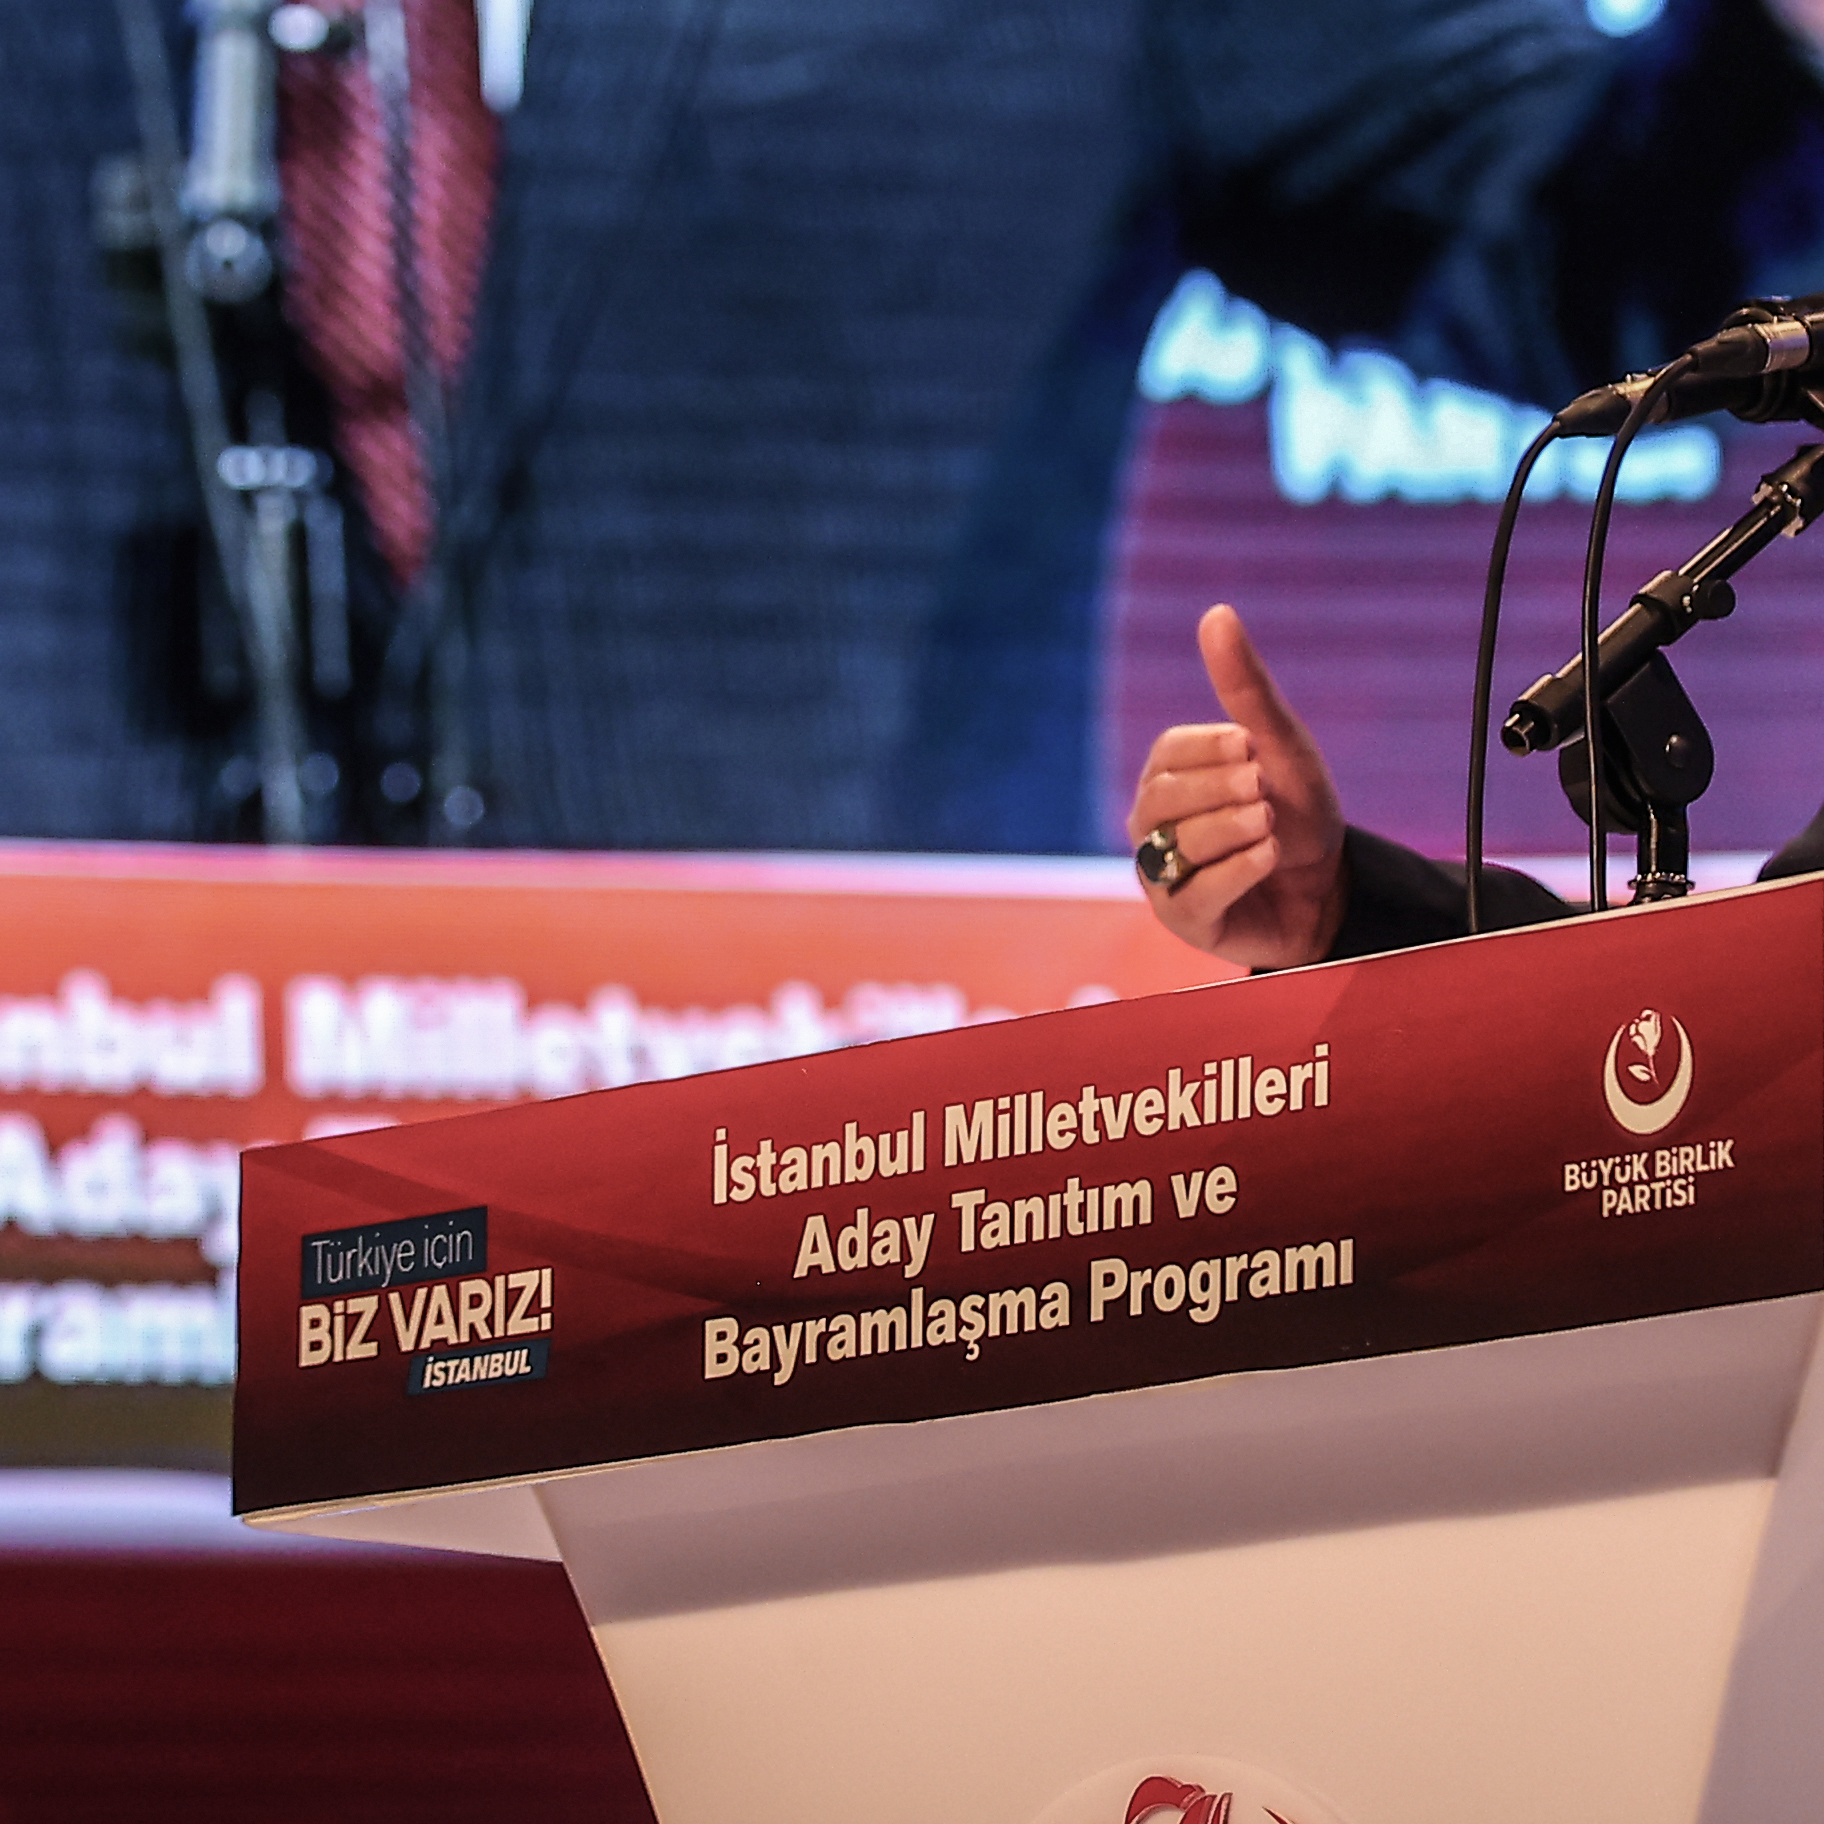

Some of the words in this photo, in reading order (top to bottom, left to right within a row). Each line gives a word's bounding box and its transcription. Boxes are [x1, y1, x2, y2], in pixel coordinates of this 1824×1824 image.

[712, 1110, 926, 1204] İstanbul
[943, 1043, 1330, 1168] Milletvekilleri
[1564, 1152, 1649, 1192] BÜYÜK
[1655, 1139, 1735, 1180] BİRLİK
[793, 1207, 935, 1278] Aday
[951, 1176, 1152, 1252] Tanıtım
[1170, 1165, 1237, 1219] ve
[1601, 1176, 1696, 1218] PARTİSİ
[311, 1232, 415, 1288] Türkiye
[424, 1220, 473, 1270] için
[298, 1294, 379, 1368] BİZ
[387, 1267, 553, 1353] VARIZ!
[704, 1279, 1071, 1386] Bayramlaşma
[1090, 1237, 1355, 1324] Programı
[422, 1348, 532, 1389] İSTANBUL
